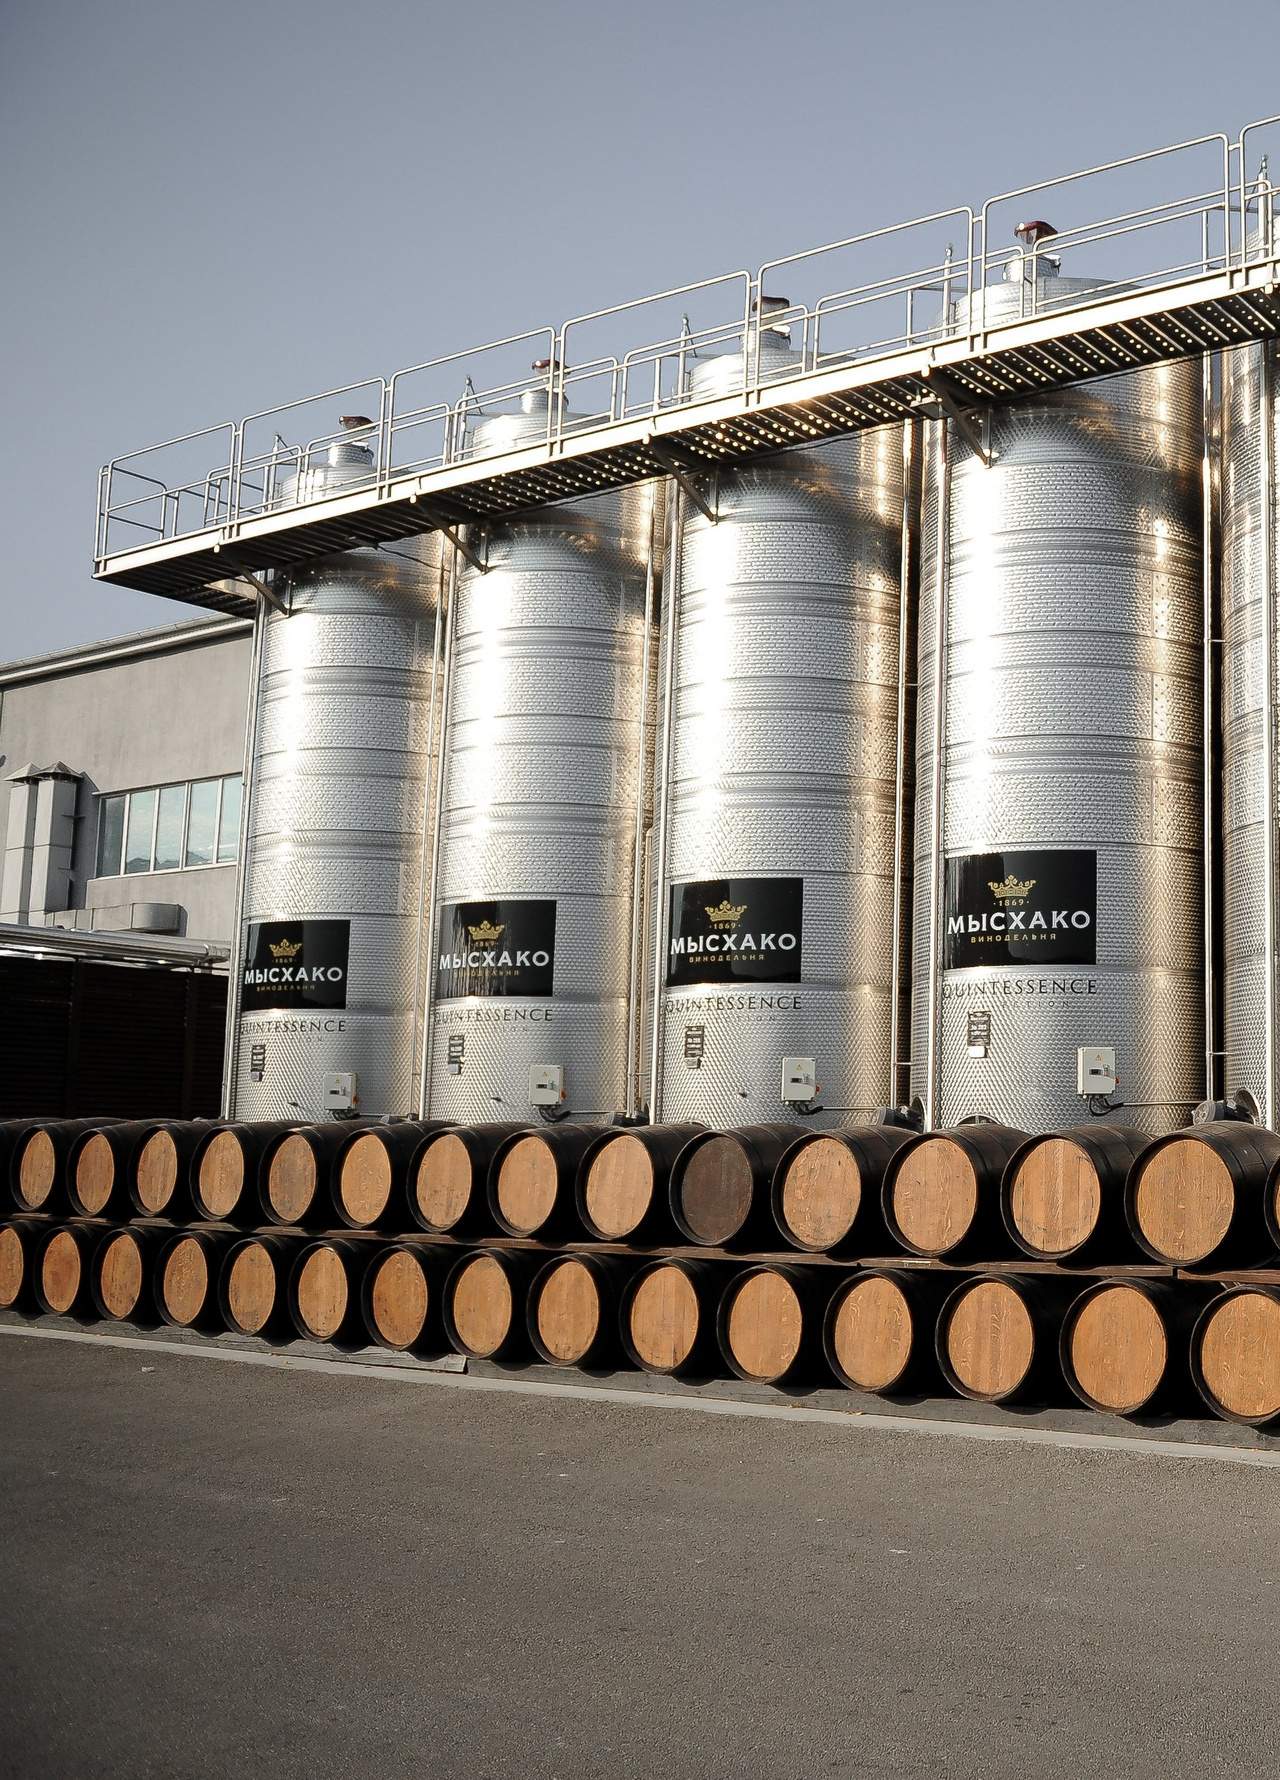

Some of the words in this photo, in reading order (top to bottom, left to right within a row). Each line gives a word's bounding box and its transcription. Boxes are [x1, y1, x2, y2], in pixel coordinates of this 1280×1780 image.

[998, 899, 1024, 907] 1869
[713, 922, 736, 930] 1869
[947, 910, 1090, 935] МЫСХАКО
[670, 933, 797, 955] МЫСХАКО
[970, 933, 1056, 943] ВИНОДЕЛЬНЯ
[439, 950, 549, 970] МЫСХАКО
[689, 954, 765, 963] ВИНОДЕЛЬНЯ
[244, 966, 343, 985] МЫСХАКО
[942, 979, 1097, 999] QUINTESSENCE
[665, 996, 802, 1013] QUINTESSENCE
